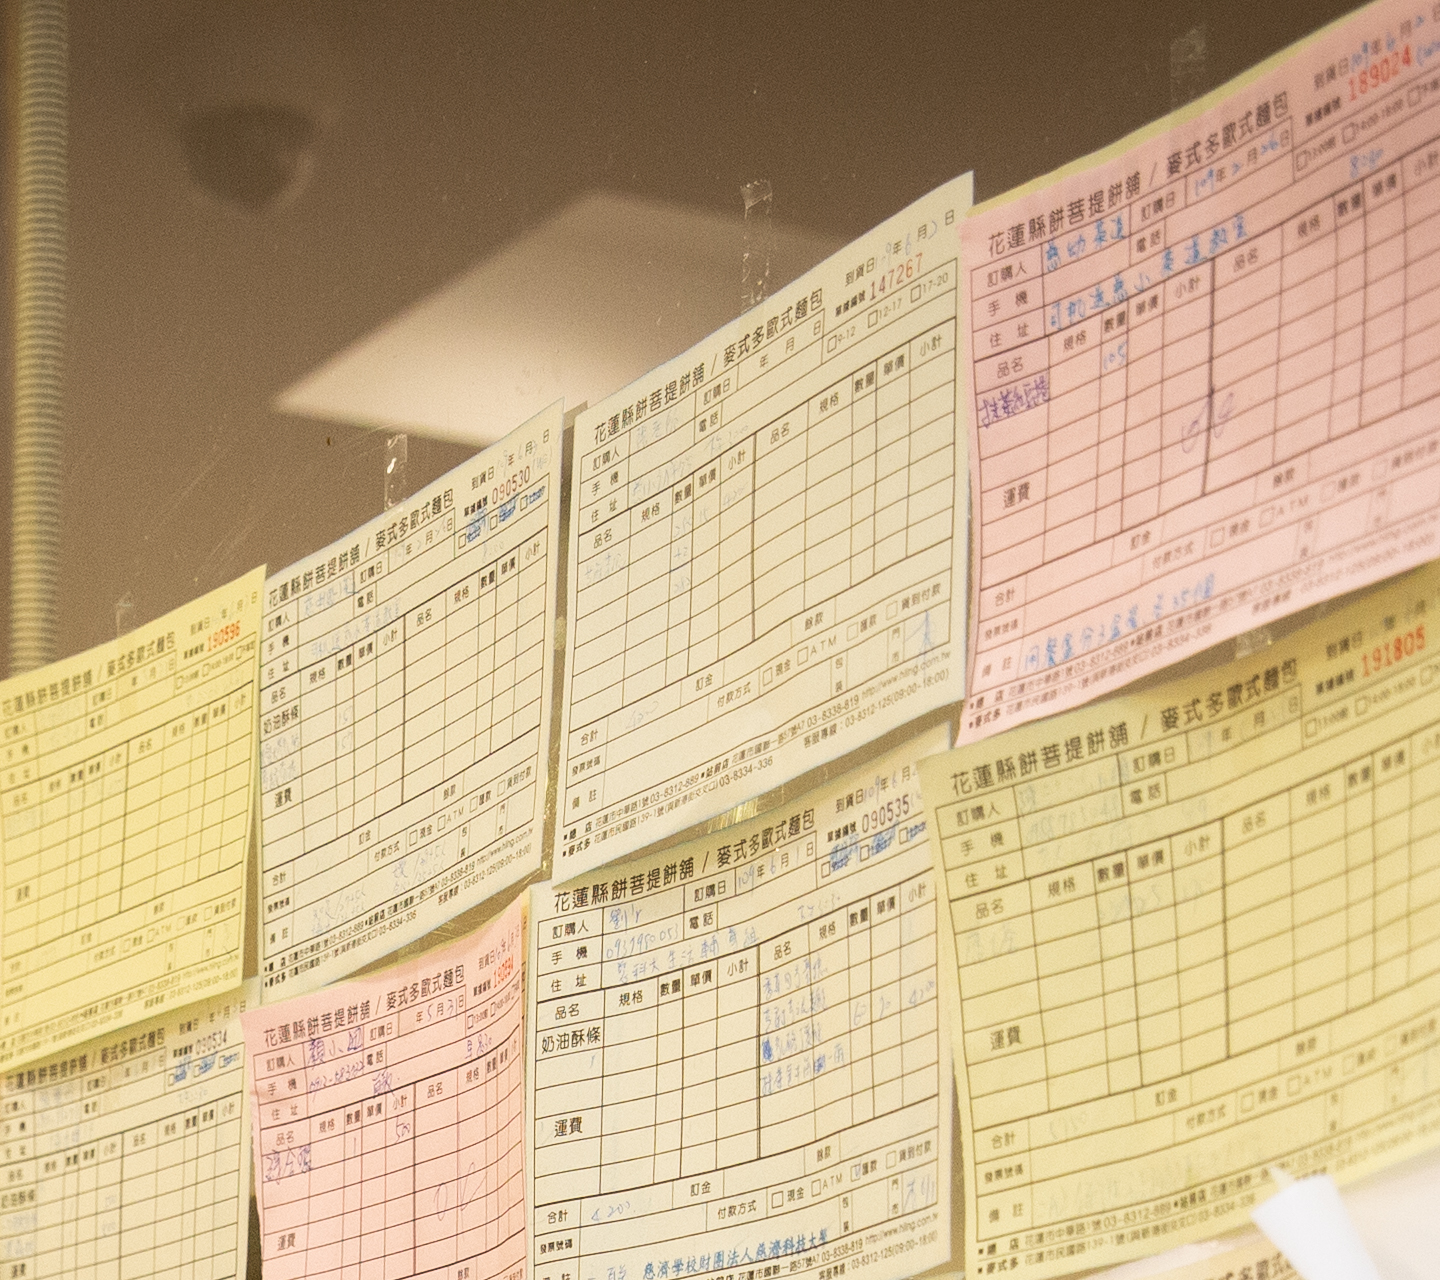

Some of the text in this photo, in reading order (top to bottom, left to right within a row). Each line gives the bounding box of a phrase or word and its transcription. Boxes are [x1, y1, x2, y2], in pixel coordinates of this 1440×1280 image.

[1347, 44, 1411, 102] 189024
[988, 91, 1289, 259] 花蓮縣餅菩提餅舖 麥式多歐式麵包
[870, 253, 923, 301] 147267
[987, 262, 1026, 288] 訂購人
[594, 287, 823, 445] 花蓮縣餅菩提餅舖 麥式多歐式麵包
[492, 466, 530, 504] 090530
[376, 489, 453, 551] 麥式多歐式麵包
[1360, 625, 1426, 678] 191805
[951, 722, 1129, 794] 花蓮縣餅菩提餅舖
[861, 794, 909, 834] 090535
[956, 802, 999, 827] 訂購人
[554, 857, 694, 913] 花蓮縣餅菩提餅舖
[717, 808, 815, 869] 麥式多歐式麵包
[694, 881, 727, 902] 訂購日
[552, 921, 588, 939] 訂購人
[264, 1001, 370, 1048] 花蓮縣餅菩提餅舖
[386, 964, 465, 1011] 麥式多歐式麵包
[540, 1024, 601, 1055] 奶油酥條
[990, 1024, 1022, 1051] 運費
[266, 1056, 295, 1072] 訂購人
[554, 1116, 583, 1139] 運費
